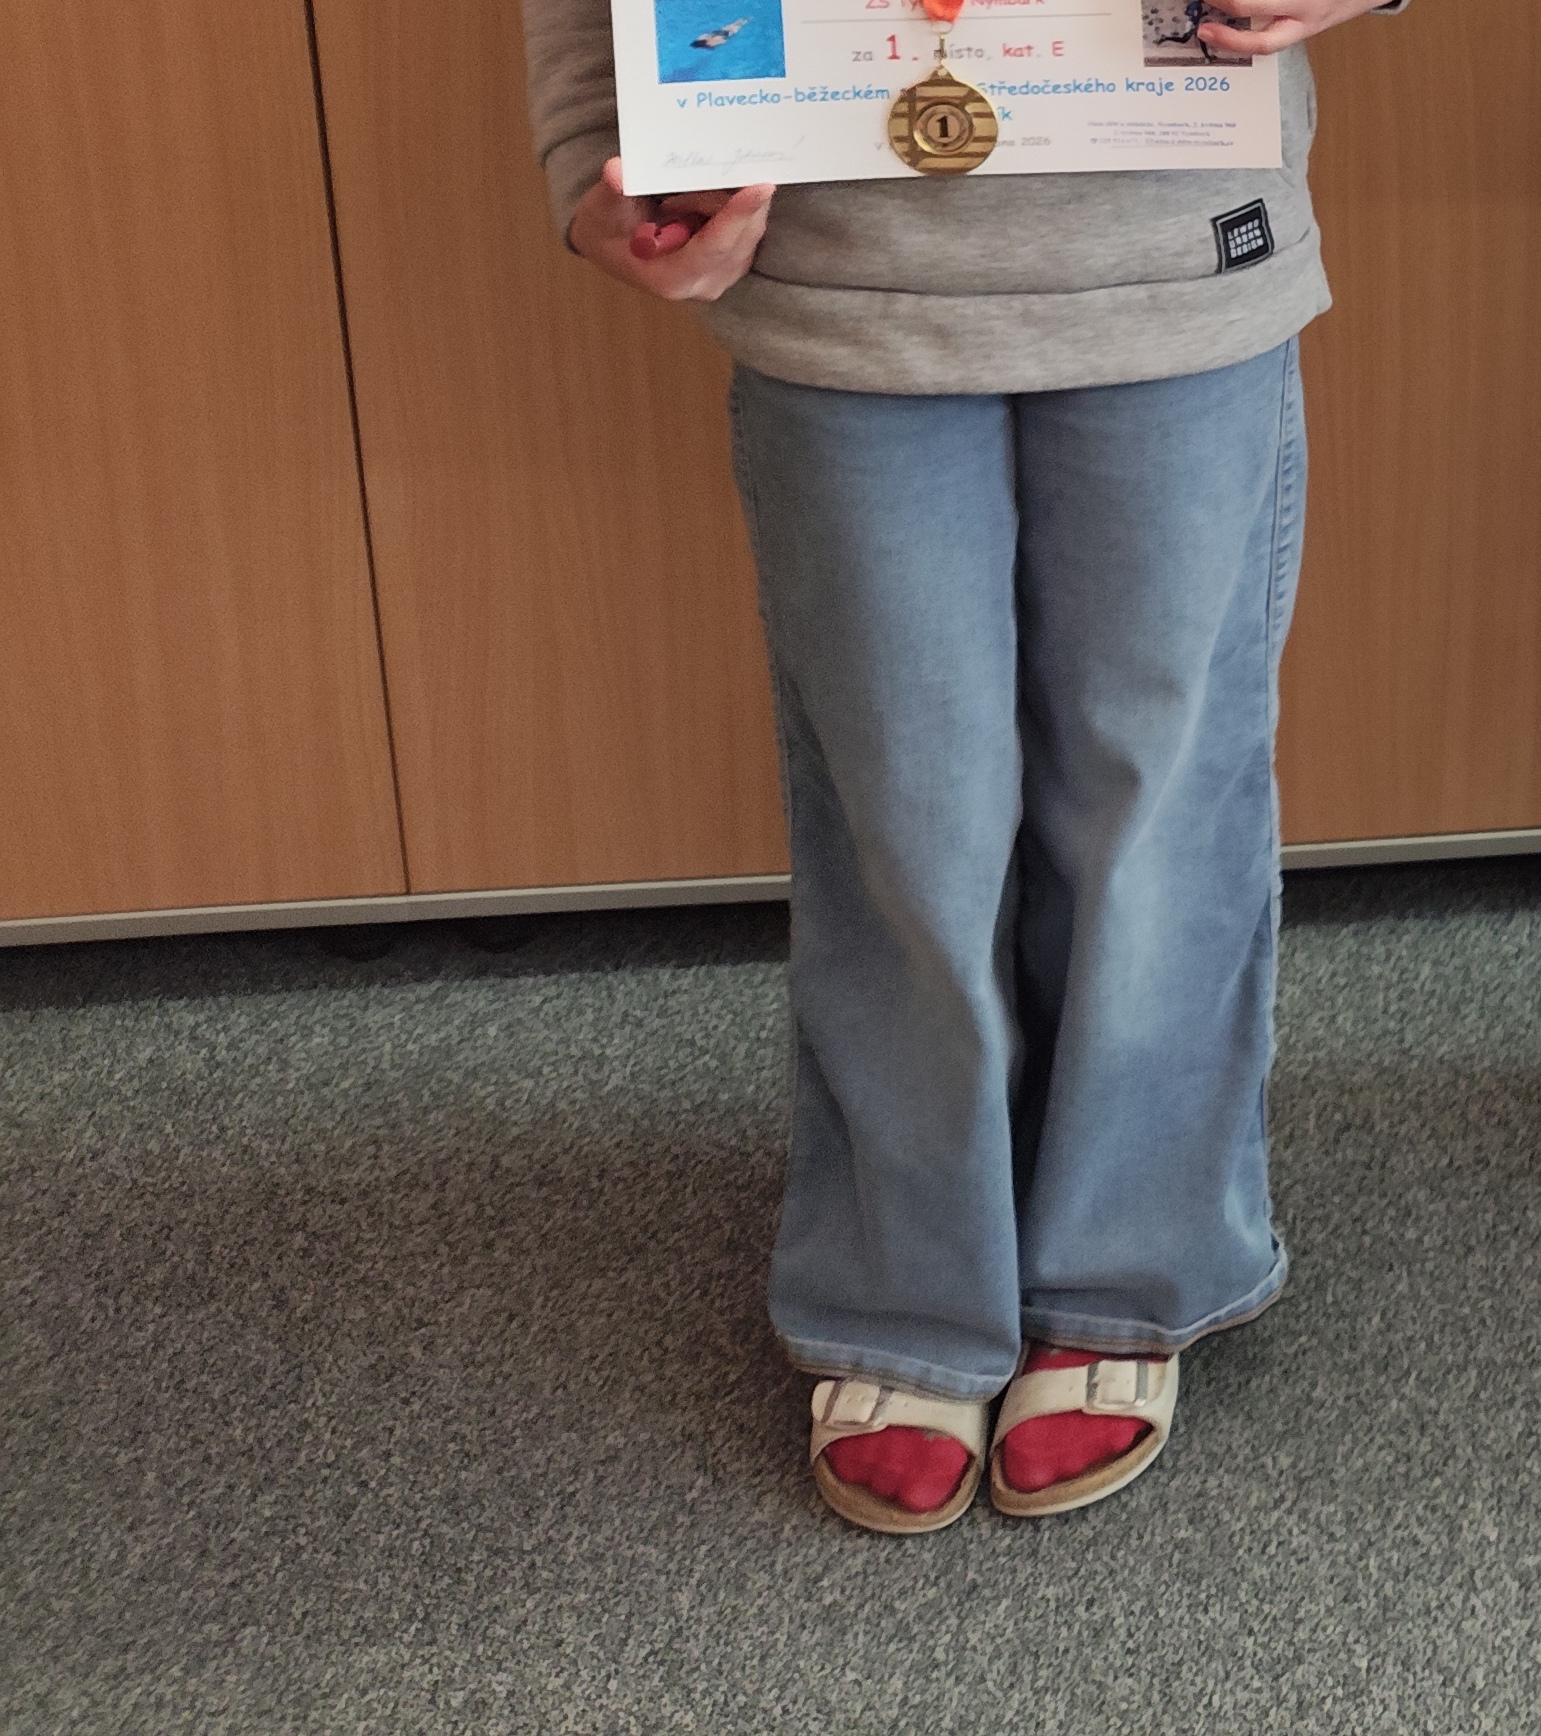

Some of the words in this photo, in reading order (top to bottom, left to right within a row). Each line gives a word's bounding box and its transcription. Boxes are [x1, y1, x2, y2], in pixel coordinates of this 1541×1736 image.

[852, 50, 873, 62] za
[1052, 41, 1064, 57] E
[677, 98, 687, 108] v
[696, 84, 890, 108] Plavecko-běžeckém
[1125, 76, 1175, 97] kraje
[1184, 76, 1230, 92] 2026
[936, 115, 949, 138] 1
